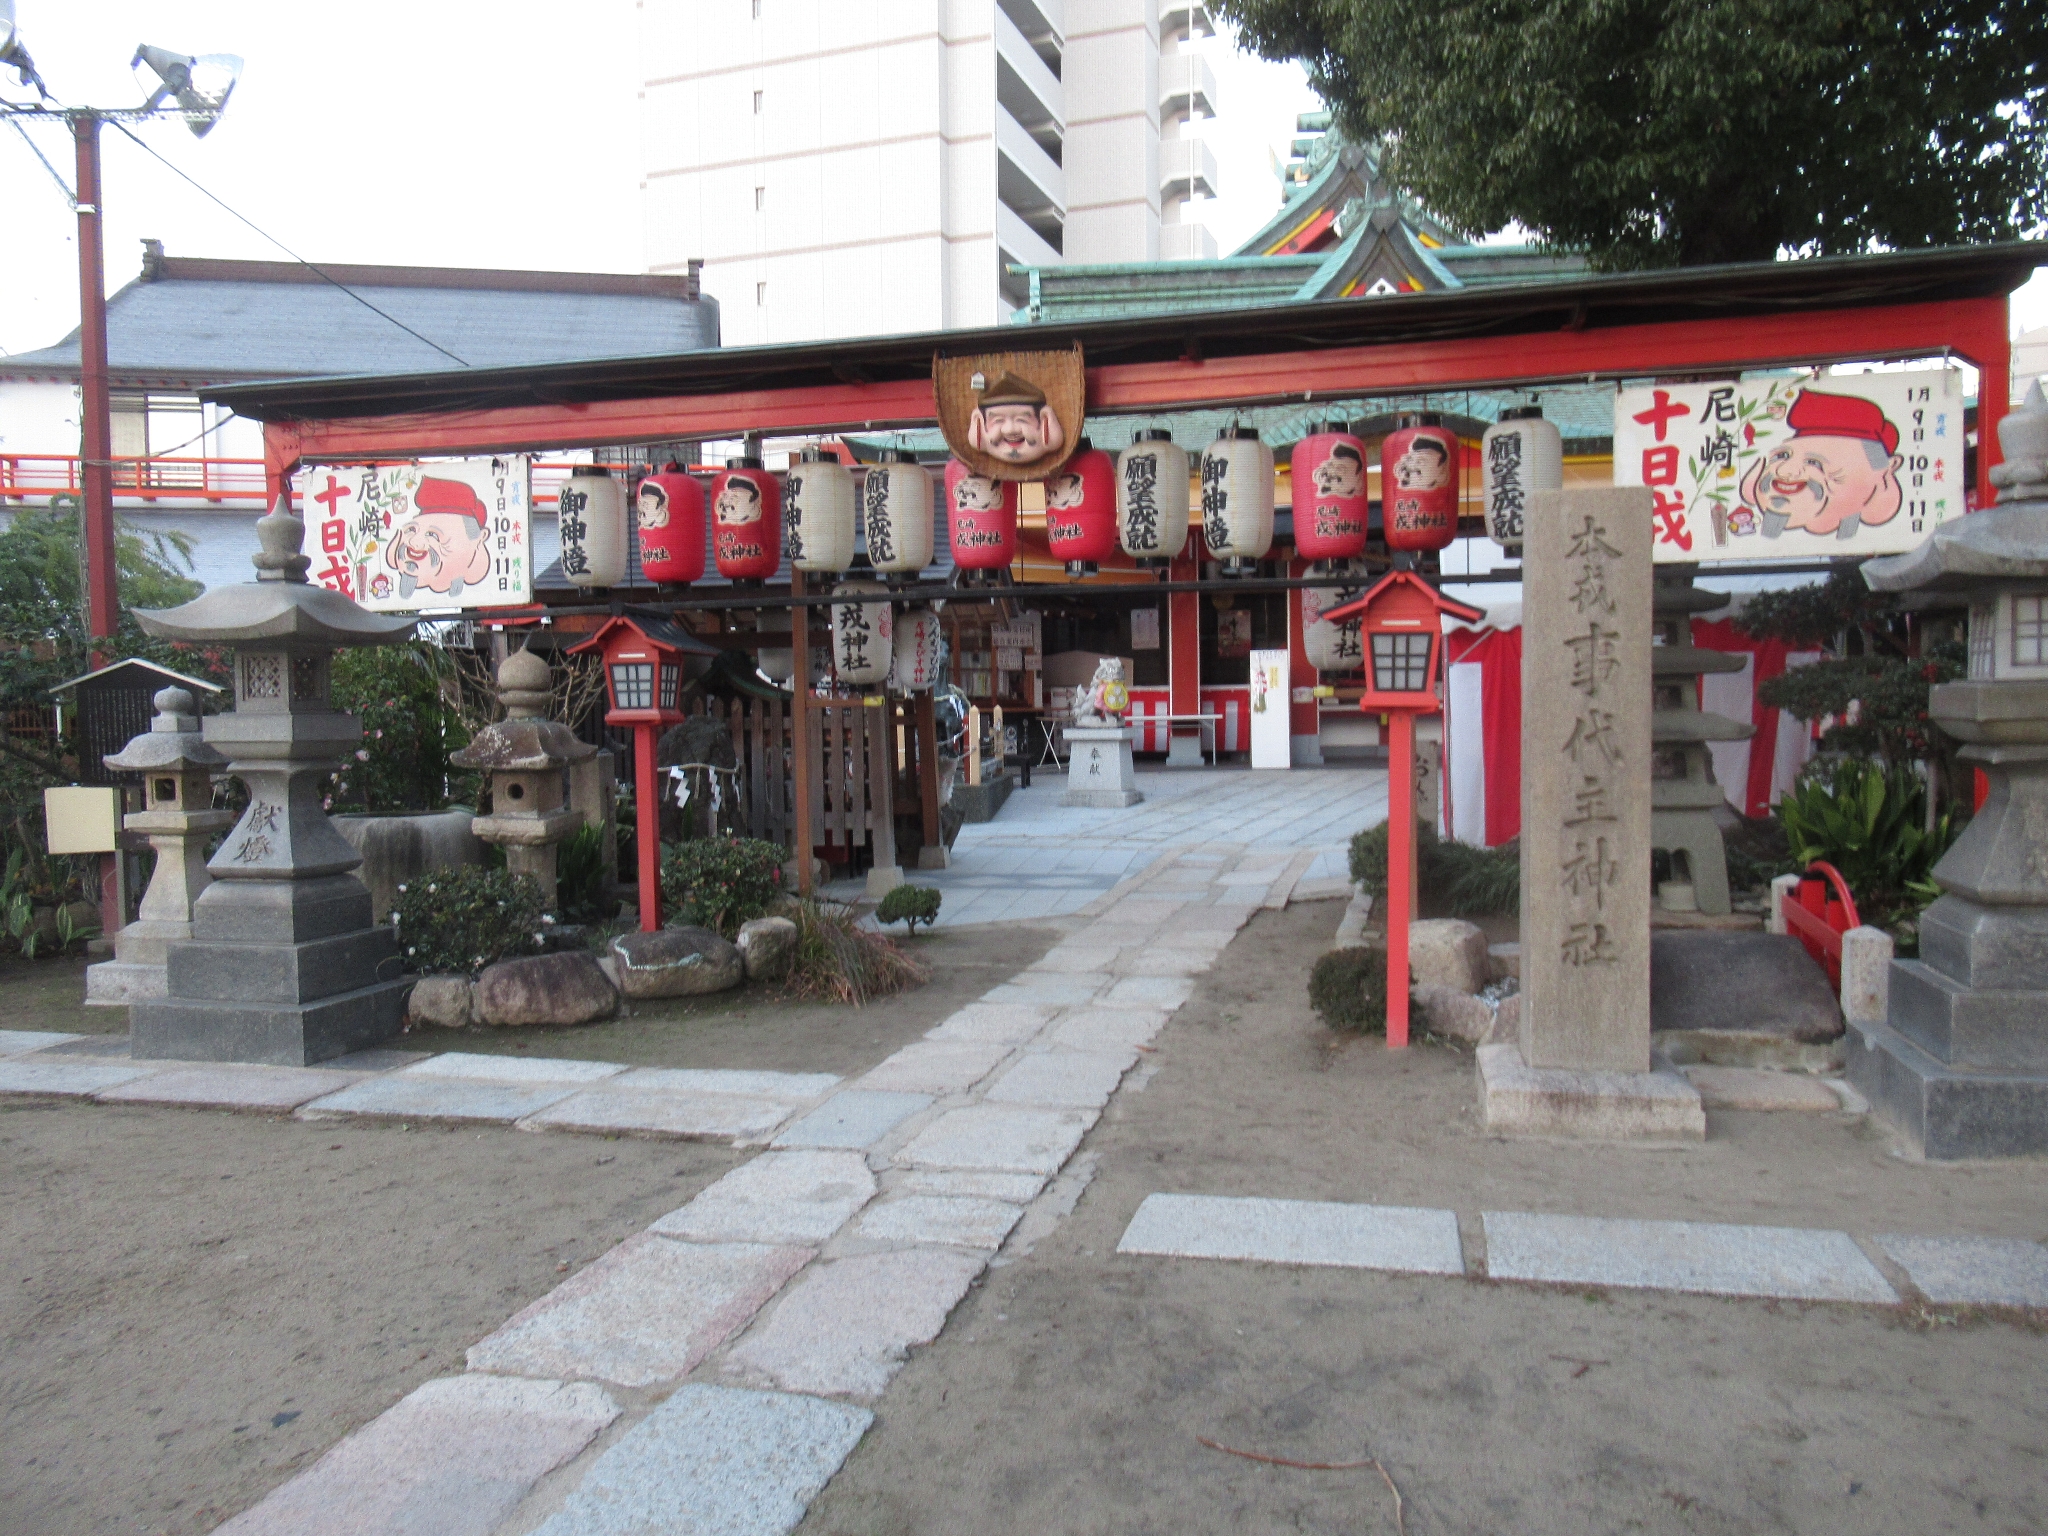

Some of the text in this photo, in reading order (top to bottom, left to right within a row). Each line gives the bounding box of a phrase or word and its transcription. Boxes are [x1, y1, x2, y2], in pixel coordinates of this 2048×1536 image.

[1631, 389, 1693, 552] 十日戎
[1699, 386, 1738, 470] 尼崎
[356, 469, 386, 539] 尼崎
[866, 467, 896, 565] 願望成就
[1125, 453, 1159, 551] 願望成就
[1488, 430, 1524, 539] 願望成就
